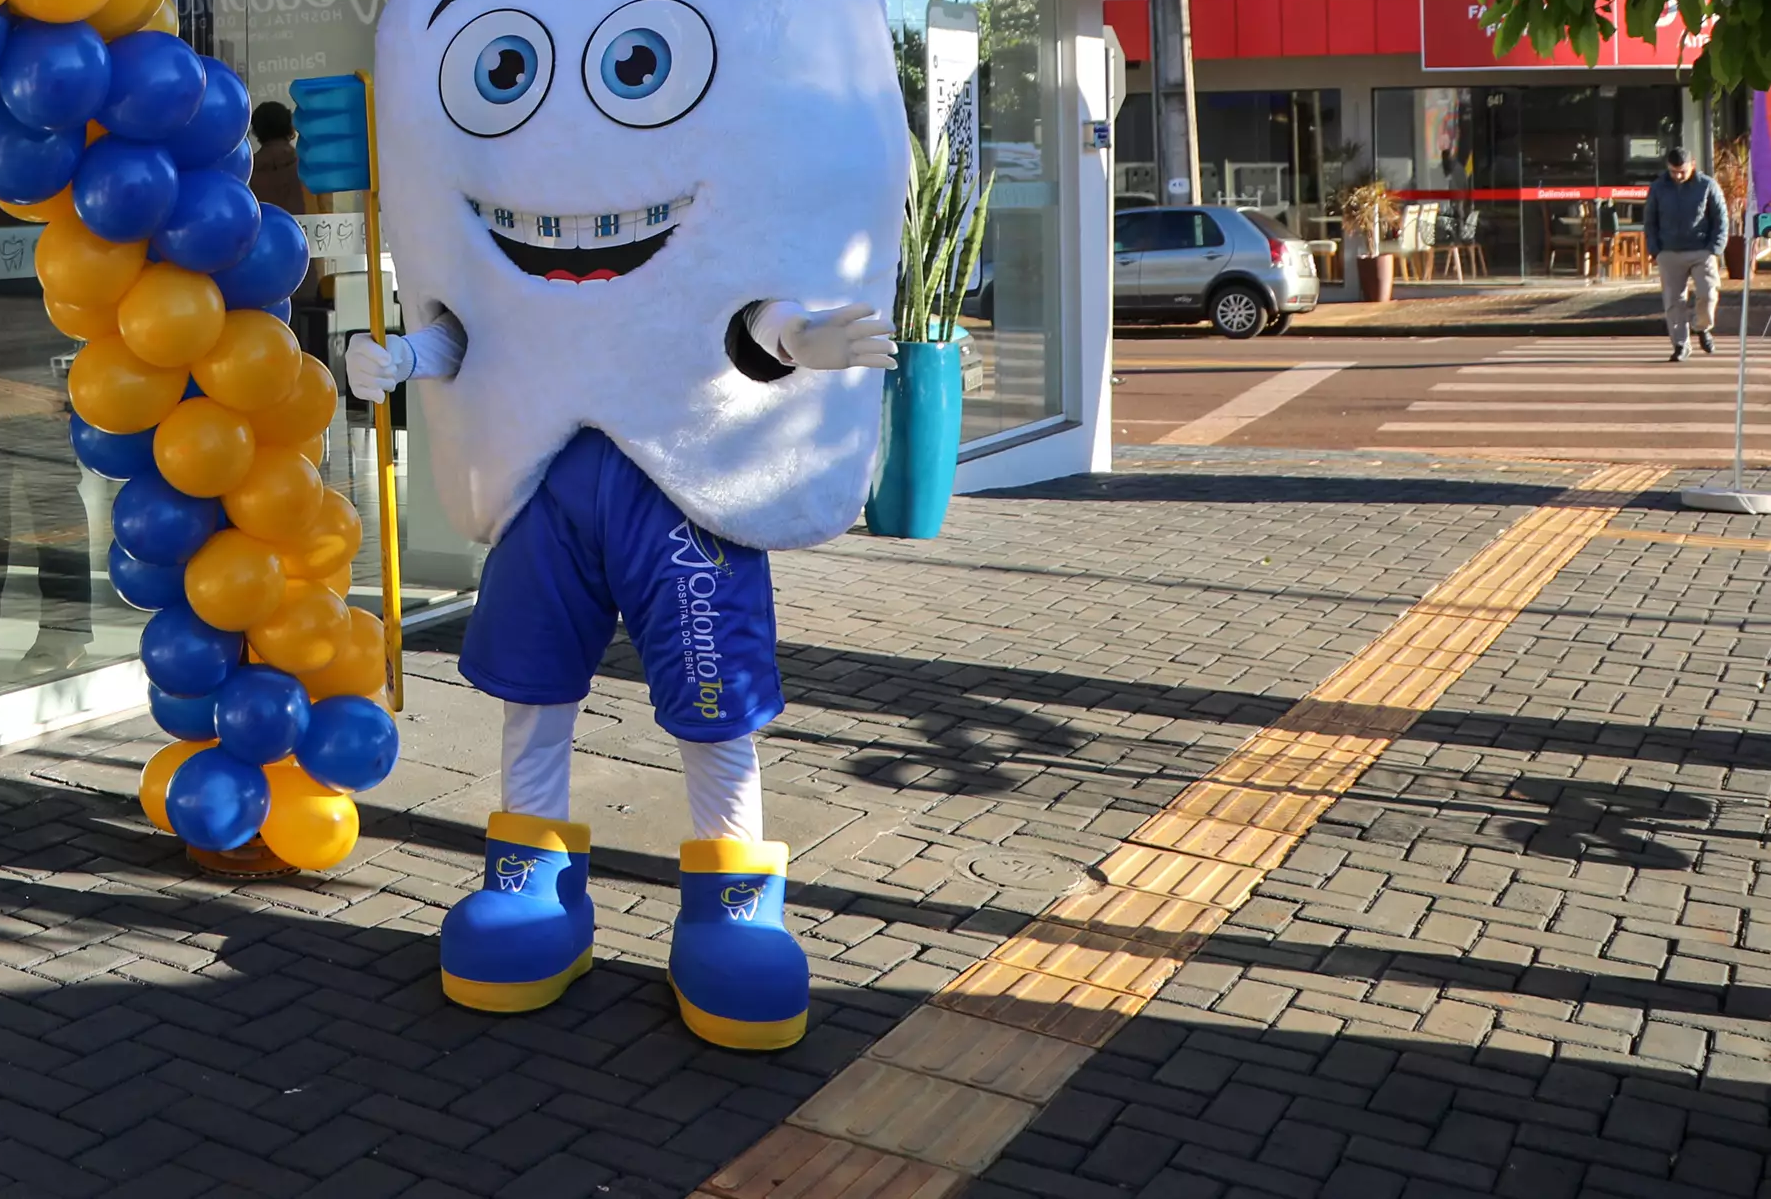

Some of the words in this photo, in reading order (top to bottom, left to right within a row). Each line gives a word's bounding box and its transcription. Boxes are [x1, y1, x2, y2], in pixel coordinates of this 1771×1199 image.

[676, 576, 688, 626] HOSPITAL
[681, 630, 692, 646] DO
[683, 650, 696, 683] DENTE
